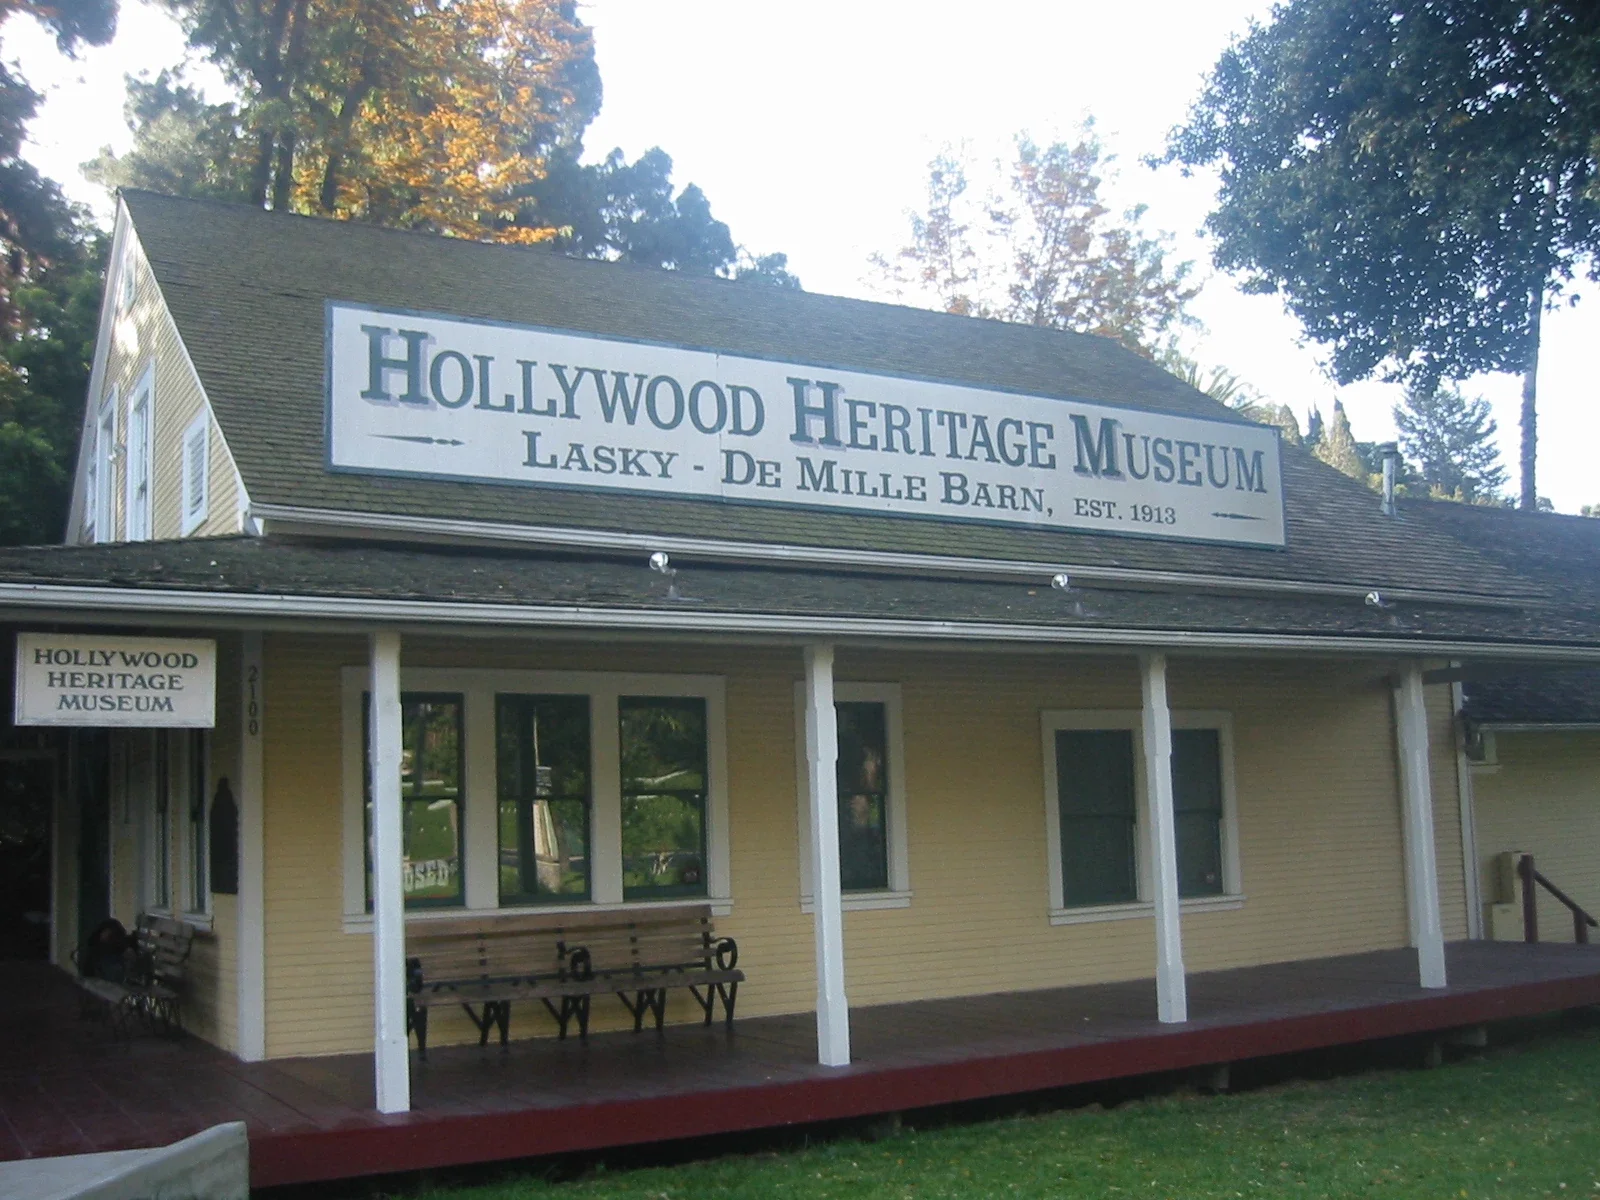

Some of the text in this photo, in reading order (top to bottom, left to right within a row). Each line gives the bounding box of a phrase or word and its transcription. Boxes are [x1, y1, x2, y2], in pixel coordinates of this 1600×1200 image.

[360, 324, 1268, 494] HOLLYWOOD HERITAGE MUSEUM
[521, 430, 679, 479] LASKY
[720, 449, 782, 488] DE
[795, 456, 927, 502] MILLE
[939, 471, 1054, 518] BARN,
[1073, 498, 1123, 521] EST.
[1130, 504, 1176, 526] 1913
[34, 648, 199, 669] HOLLYWOOD
[47, 672, 184, 690] HERITAGE
[56, 694, 174, 712] MUSEUM
[247, 664, 259, 736] 2100
